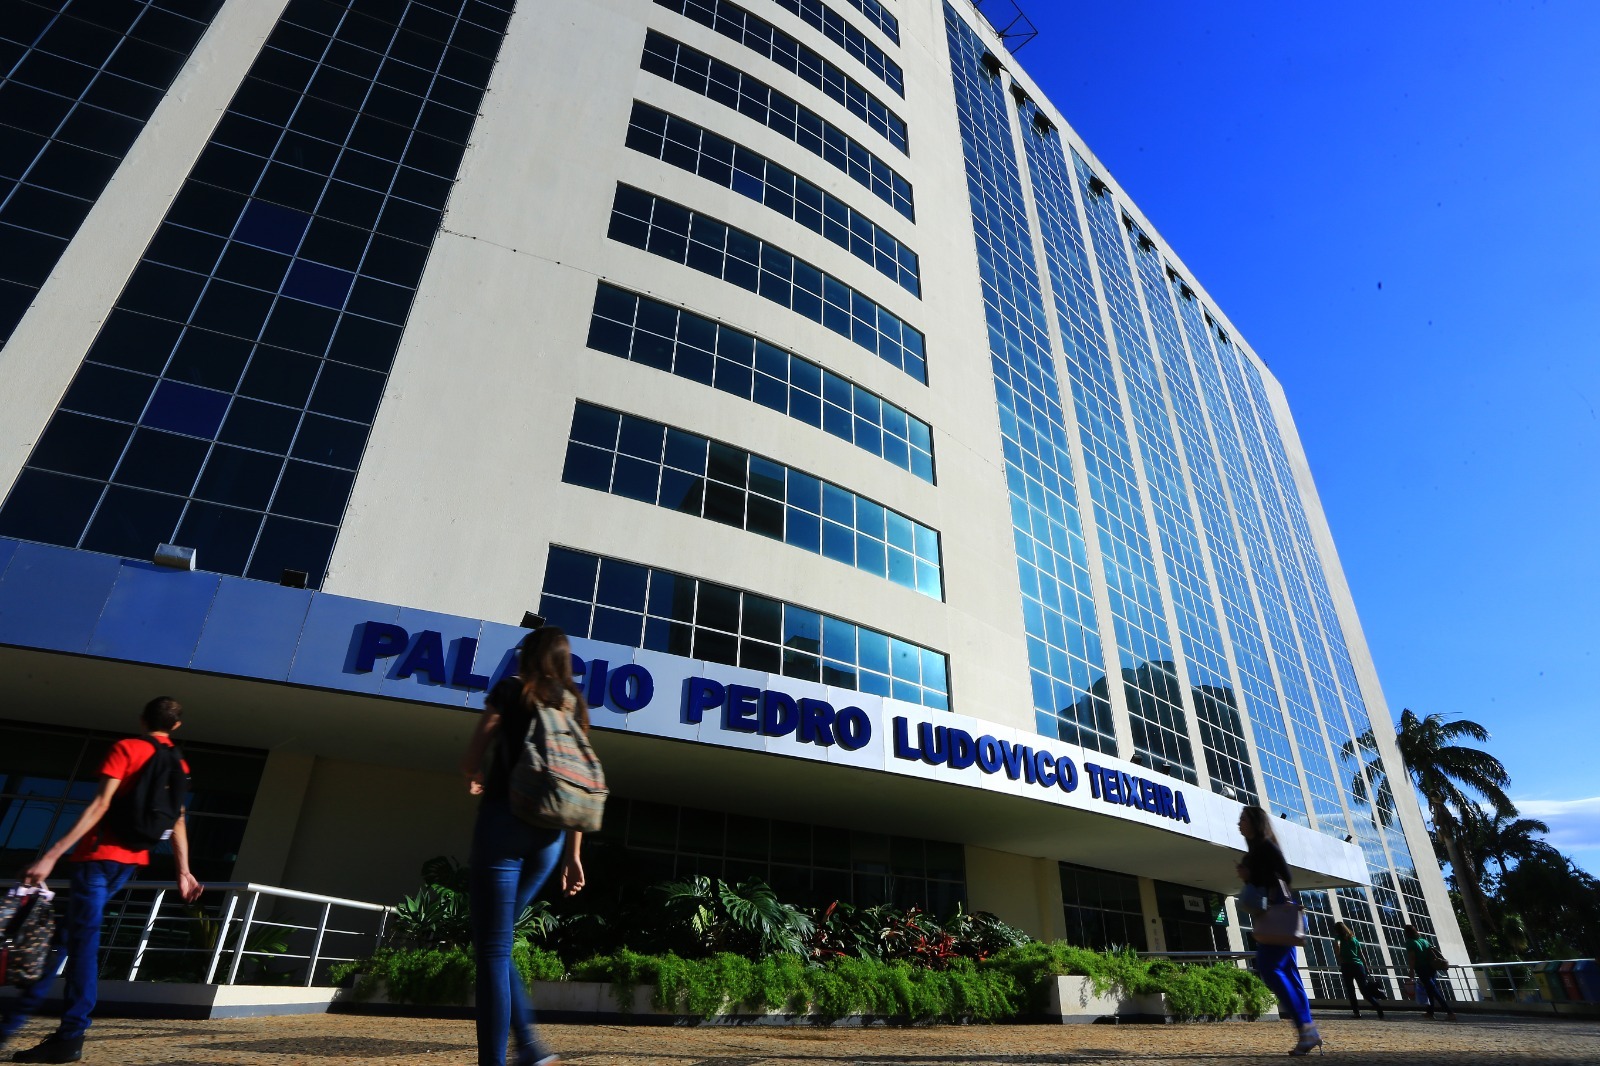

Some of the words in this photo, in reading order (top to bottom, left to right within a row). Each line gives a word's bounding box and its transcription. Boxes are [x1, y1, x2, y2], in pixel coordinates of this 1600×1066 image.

[342, 620, 655, 714] PALIO
[680, 676, 872, 751] PEDRO
[892, 716, 1079, 793] LUDOVICO
[1084, 762, 1191, 824] TEIXEIRA
